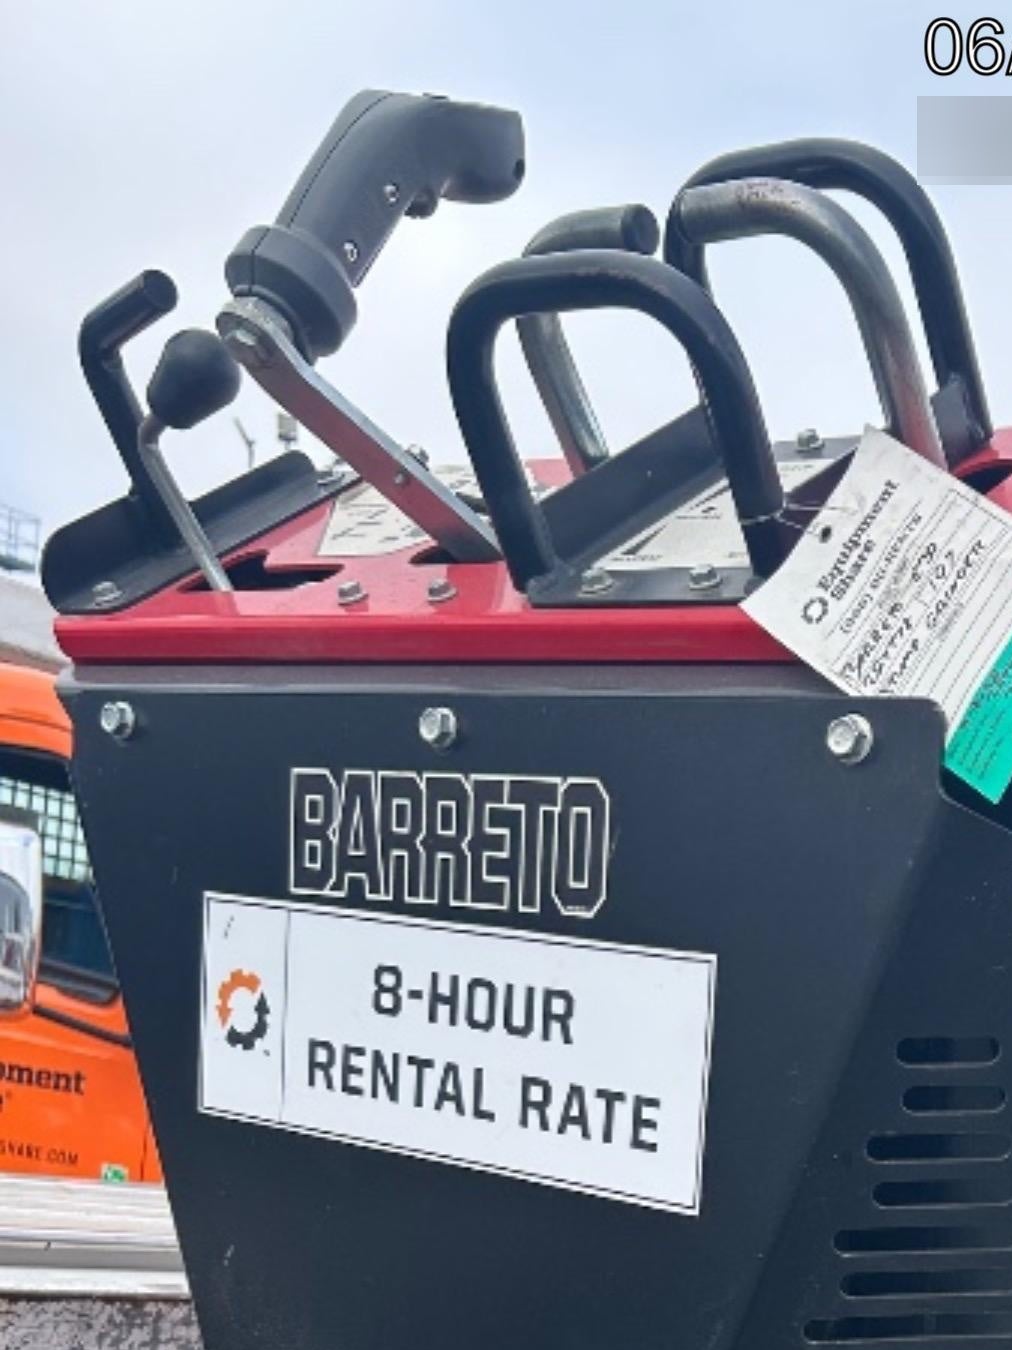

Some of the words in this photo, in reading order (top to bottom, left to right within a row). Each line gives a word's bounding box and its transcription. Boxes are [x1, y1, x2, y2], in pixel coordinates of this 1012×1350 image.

[289, 767, 610, 918] BARRETO
[373, 965, 575, 1045] 8-HOUR
[307, 1038, 496, 1123] RENTAL
[519, 1075, 661, 1152] RATE
